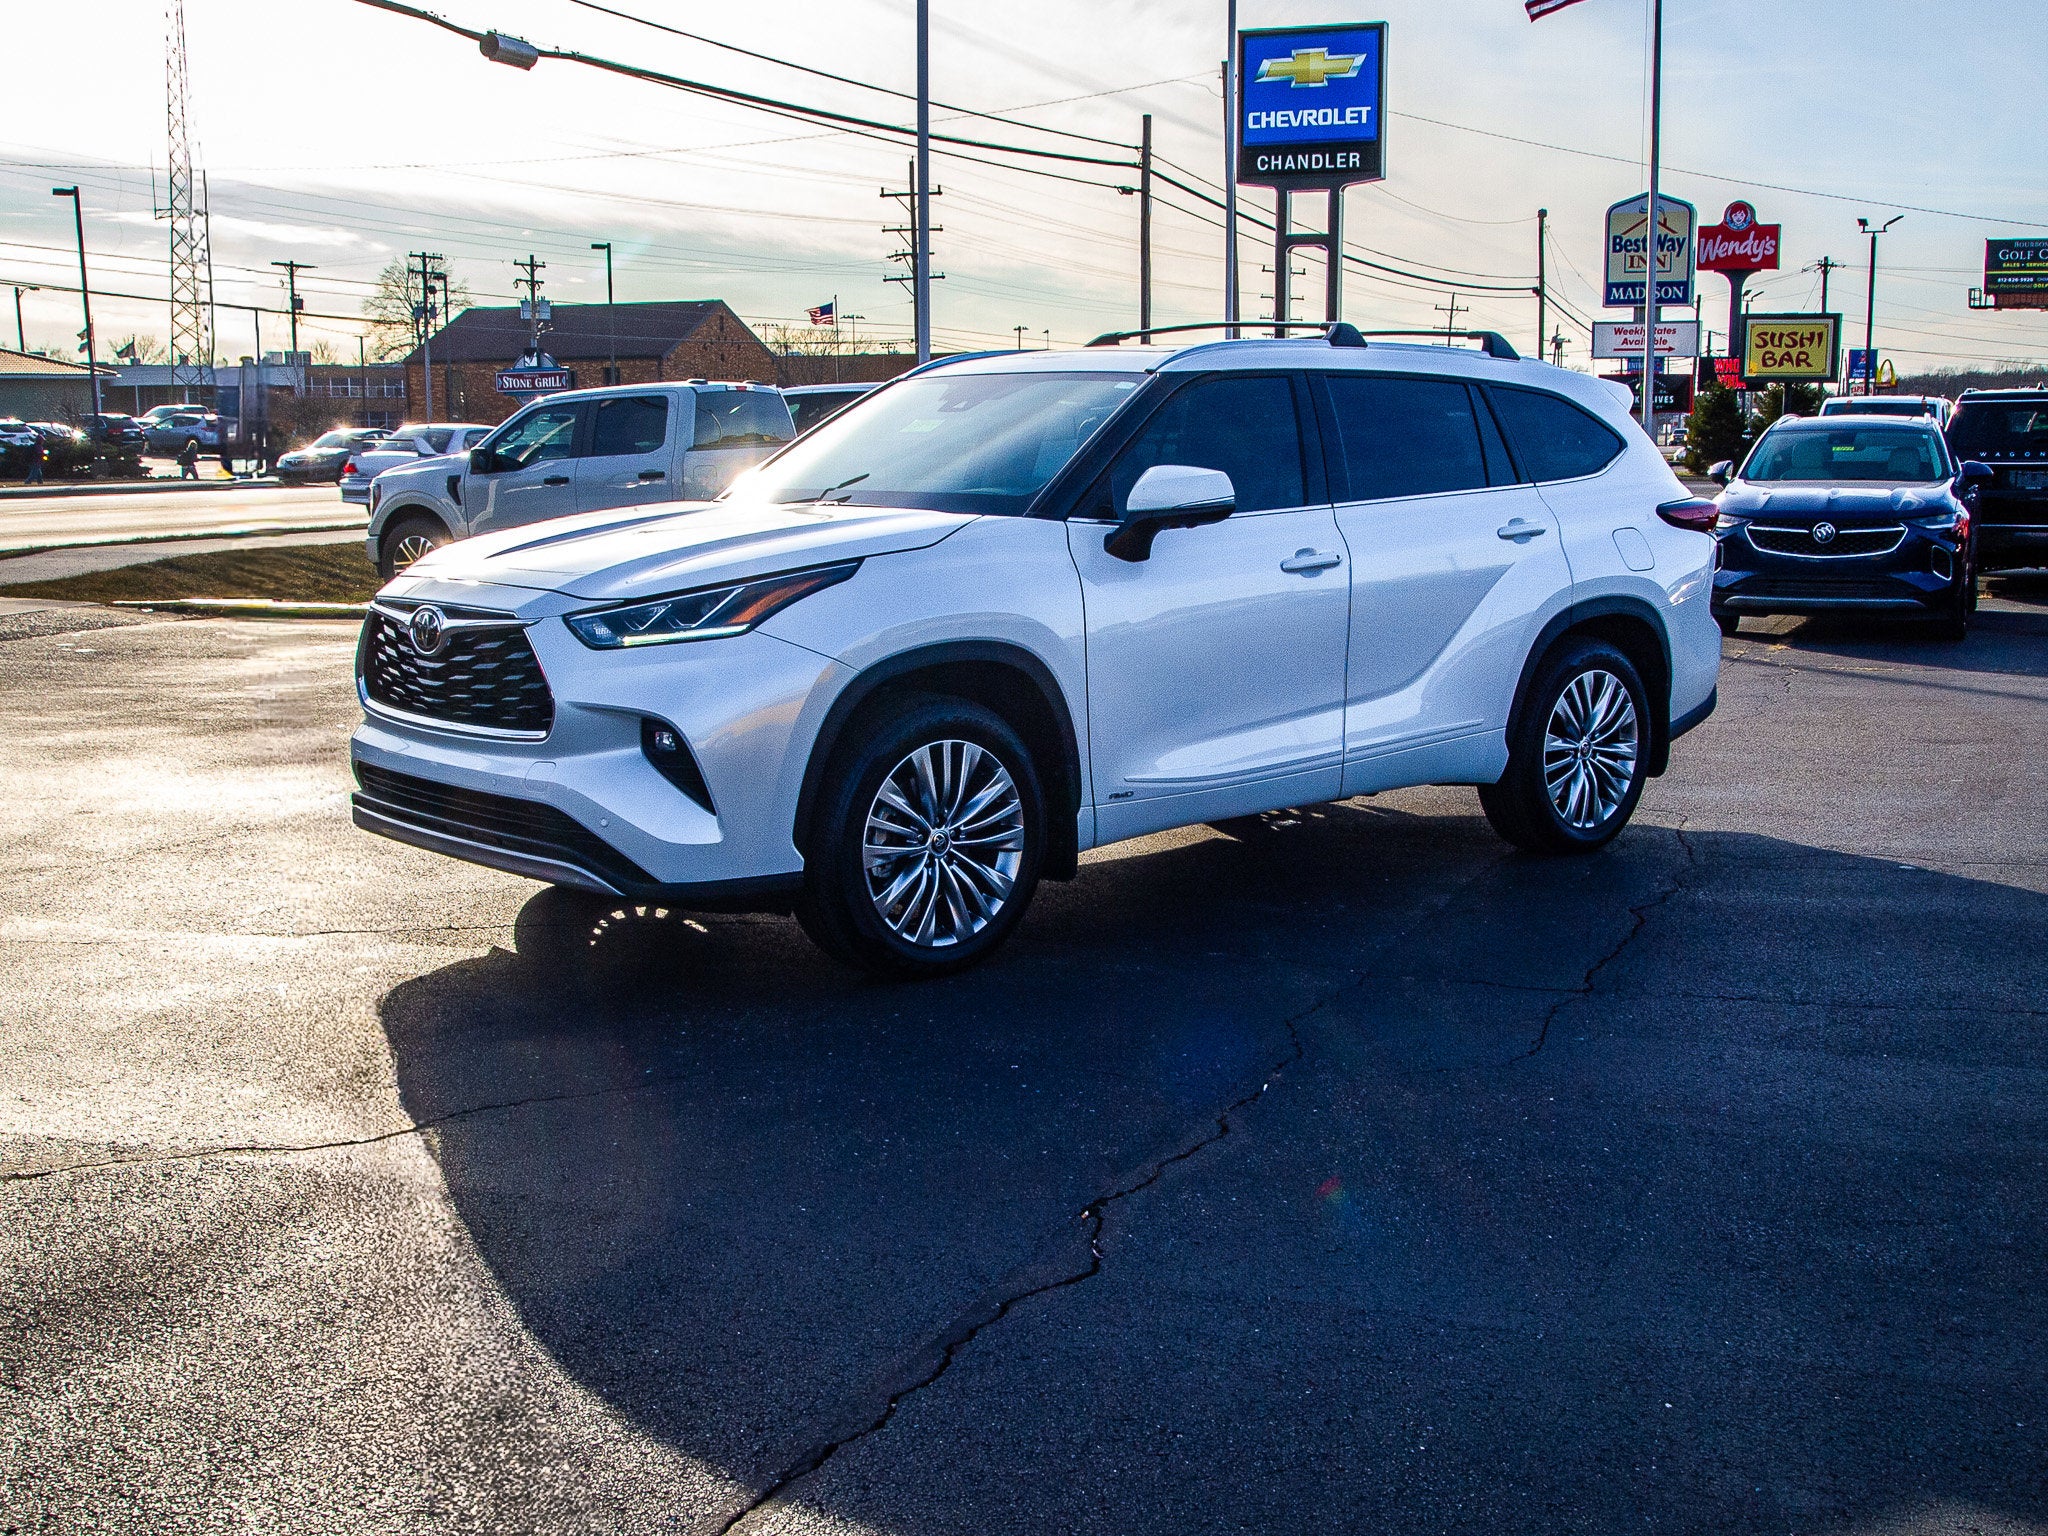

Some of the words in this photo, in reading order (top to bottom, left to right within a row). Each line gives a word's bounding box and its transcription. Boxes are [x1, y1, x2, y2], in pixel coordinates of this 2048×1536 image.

[1248, 106, 1371, 129] CHEVROLET
[1257, 152, 1360, 171] CHANDLER
[1699, 230, 1776, 264] Wendy's
[1998, 249, 2034, 260] GOLF
[1610, 286, 1684, 300] MADSON
[1653, 327, 1677, 335] ates
[1621, 337, 1668, 346] Avaible
[1755, 331, 1824, 349] SUSHI
[1761, 350, 1814, 368] BAR
[502, 376, 532, 389] STONE
[534, 375, 562, 388] GRILL
[1653, 395, 1675, 404] IVES
